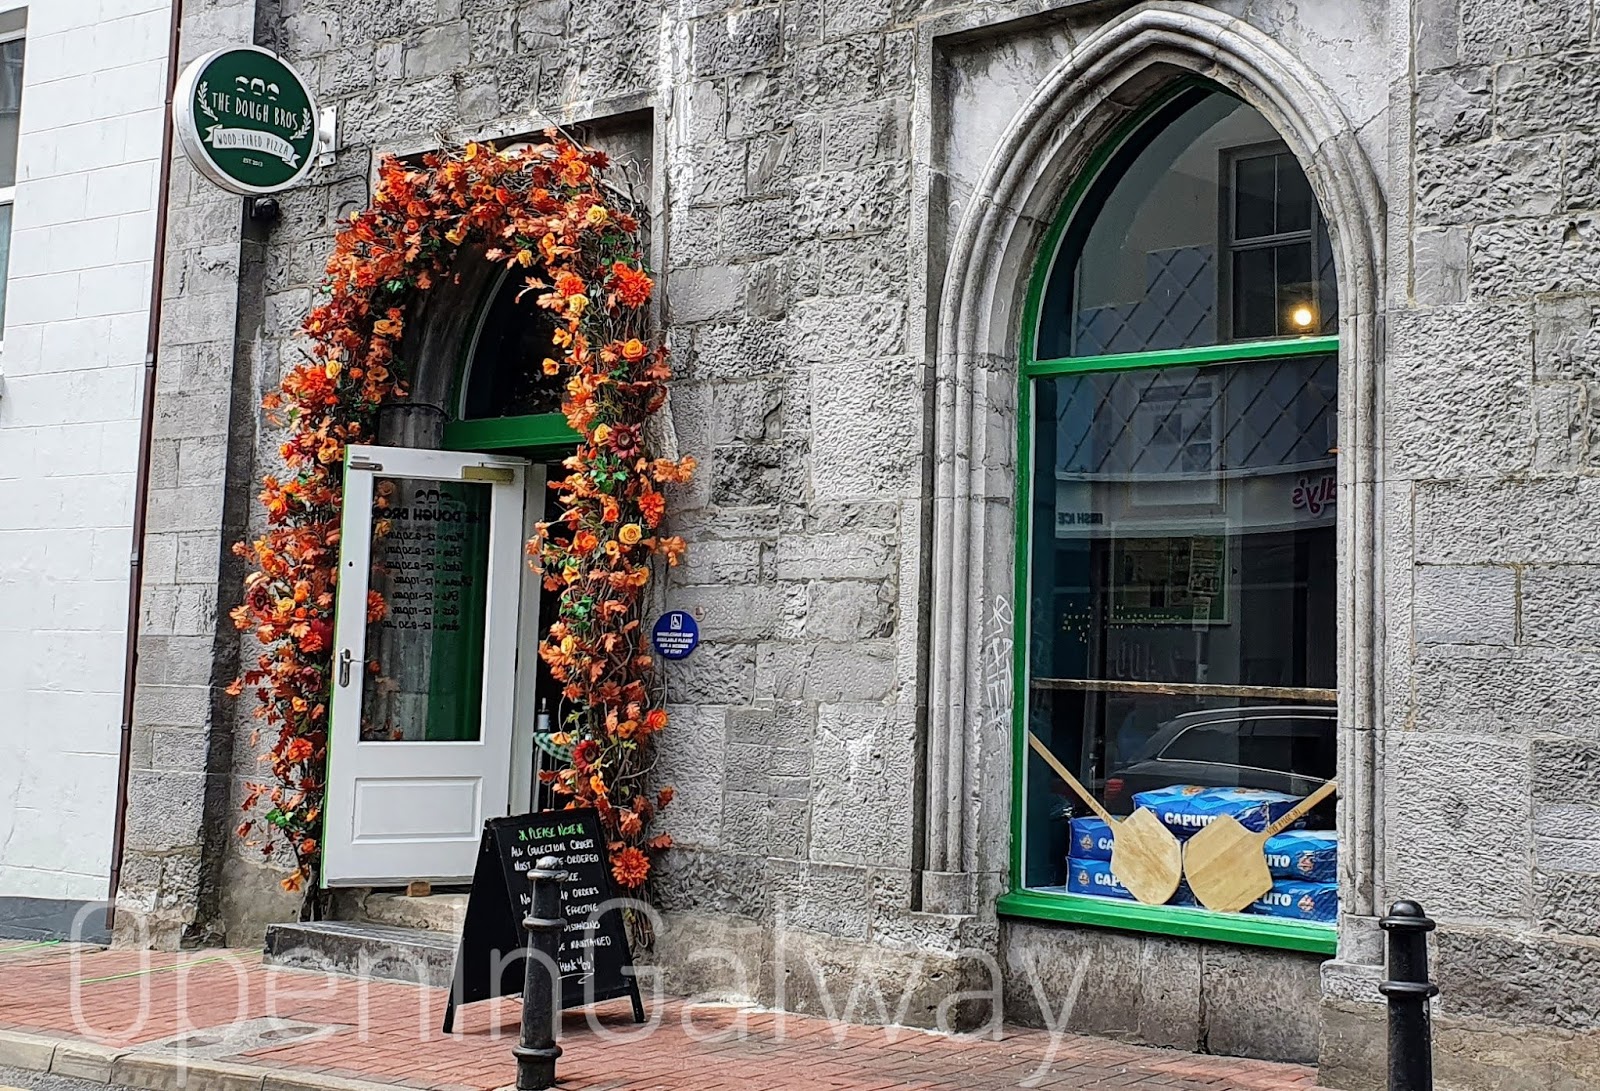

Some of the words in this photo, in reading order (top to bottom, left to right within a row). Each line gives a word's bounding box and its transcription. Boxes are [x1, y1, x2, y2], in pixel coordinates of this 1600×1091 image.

[212, 92, 231, 113] THE
[235, 97, 269, 123] DOUGH
[274, 106, 298, 131] BROS
[216, 132, 263, 148] WOOD-FIRED
[266, 137, 289, 156] PIZZA
[528, 827, 556, 840] PLEASE
[557, 823, 576, 836] NOTE
[511, 846, 523, 857] ALL
[527, 842, 566, 857] COLLECTION
[570, 839, 594, 850] ORDERS
[1264, 854, 1290, 868] UTO
[1094, 872, 1125, 888] CAP
[572, 886, 599, 898] ORDERS
[1261, 892, 1292, 906] UTO
[565, 902, 599, 916] EFFECTIVE
[570, 935, 611, 949] MAINTAINED
[558, 957, 578, 972] HANK
